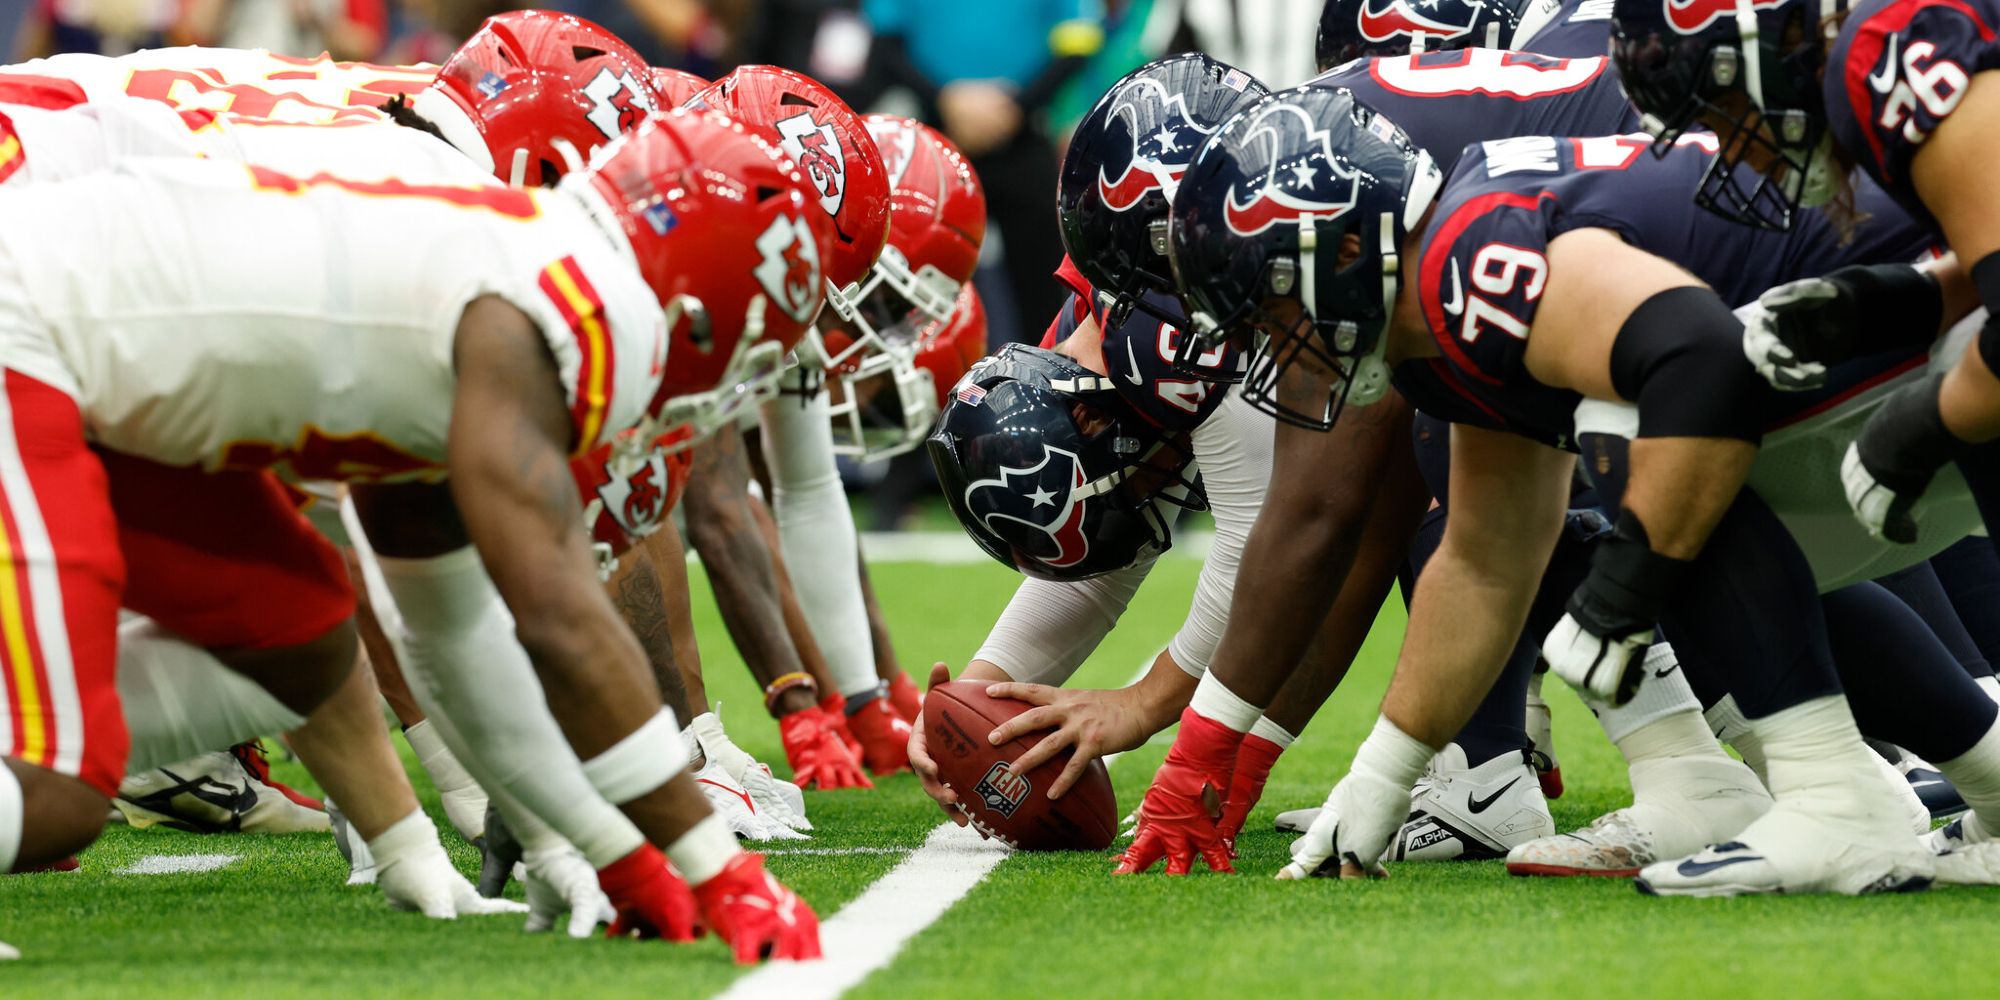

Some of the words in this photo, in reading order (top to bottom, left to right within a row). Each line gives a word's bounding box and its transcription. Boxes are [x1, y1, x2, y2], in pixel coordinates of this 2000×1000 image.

[1460, 242, 1549, 343] 79
[990, 765, 1027, 804] NFL
[1411, 828, 1453, 850] ALPHA
